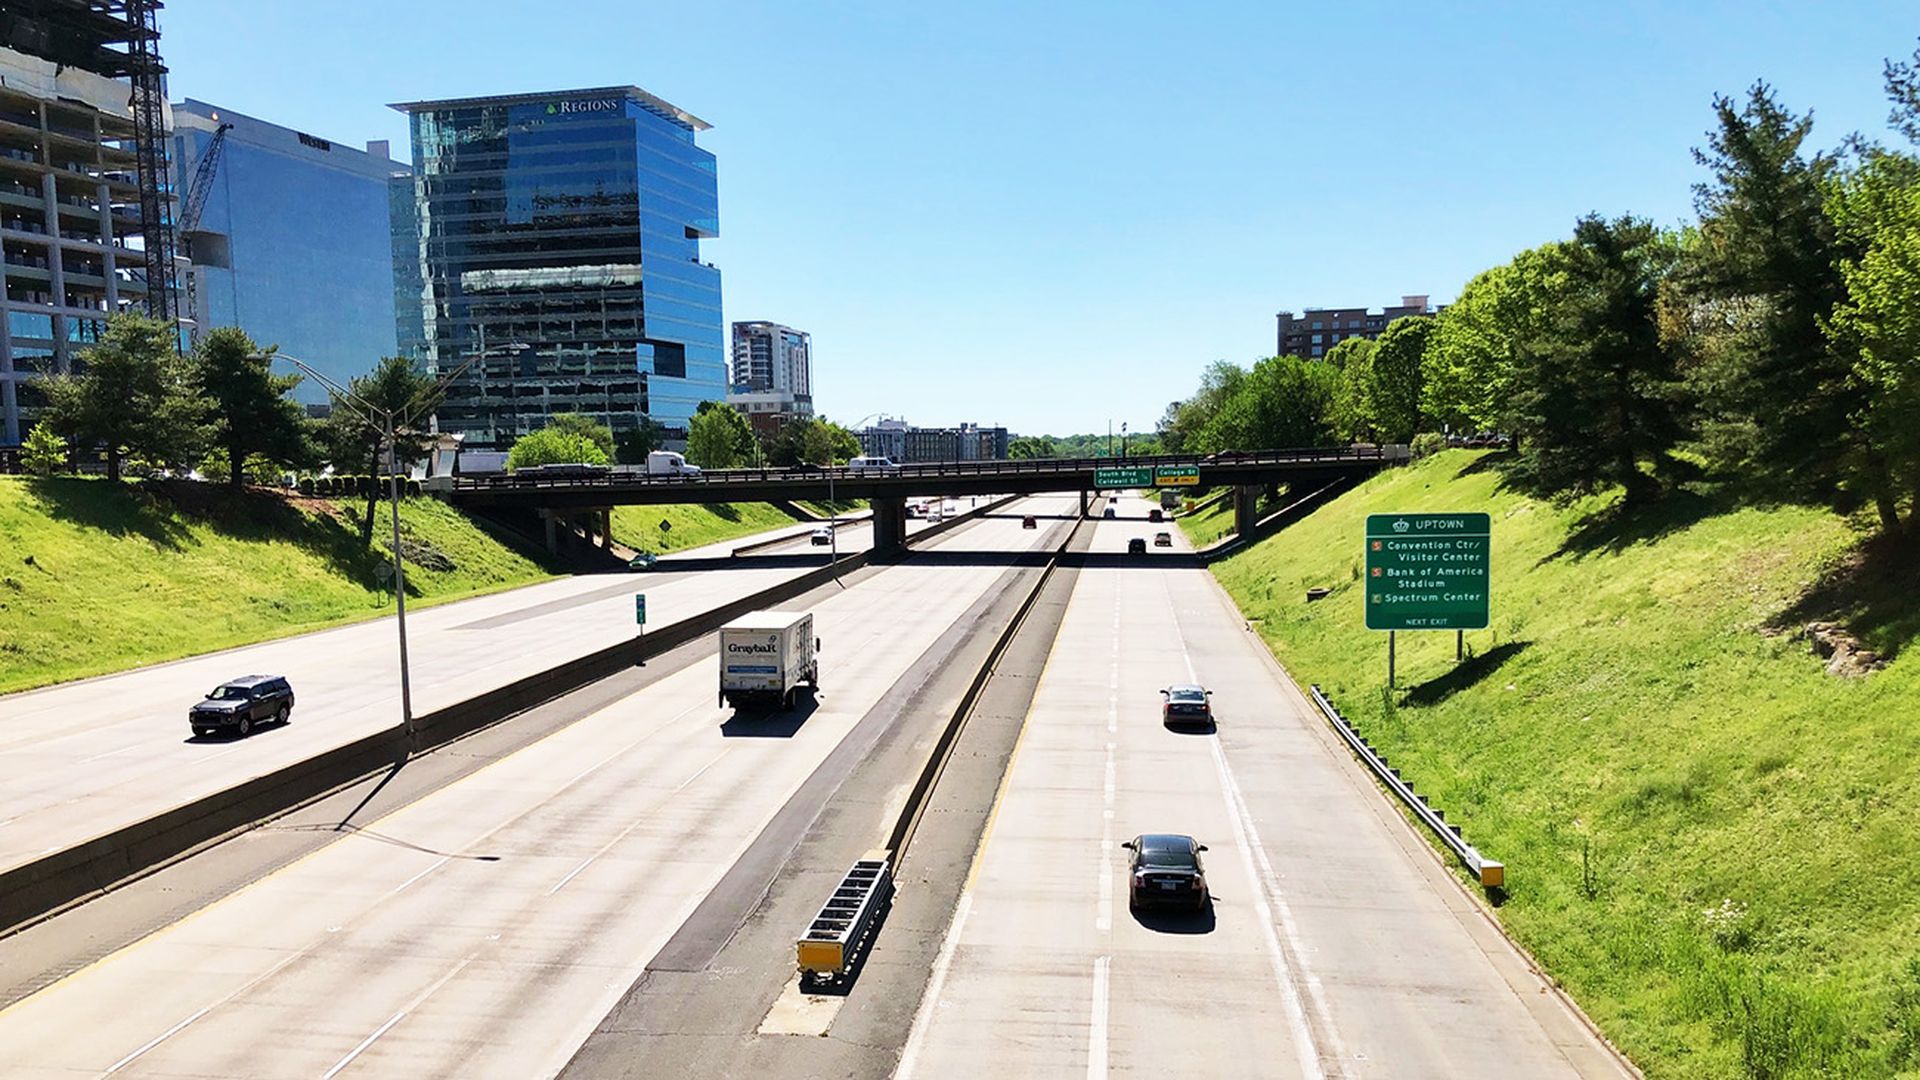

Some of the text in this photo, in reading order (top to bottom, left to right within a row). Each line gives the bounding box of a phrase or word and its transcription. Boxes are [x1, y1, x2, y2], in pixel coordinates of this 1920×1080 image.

[560, 99, 617, 113] REGIONS
[1415, 520, 1464, 529] UPTOWN
[1387, 541, 1451, 550] Convention
[1456, 540, 1481, 550] Ctr/
[1398, 553, 1481, 561] Visitor Center
[1386, 568, 1415, 577] Bank
[1420, 568, 1431, 576] of
[1436, 567, 1484, 576] America
[1398, 580, 1446, 588] Stadium
[1384, 593, 1438, 603] Spectrum
[1443, 592, 1481, 601] Center
